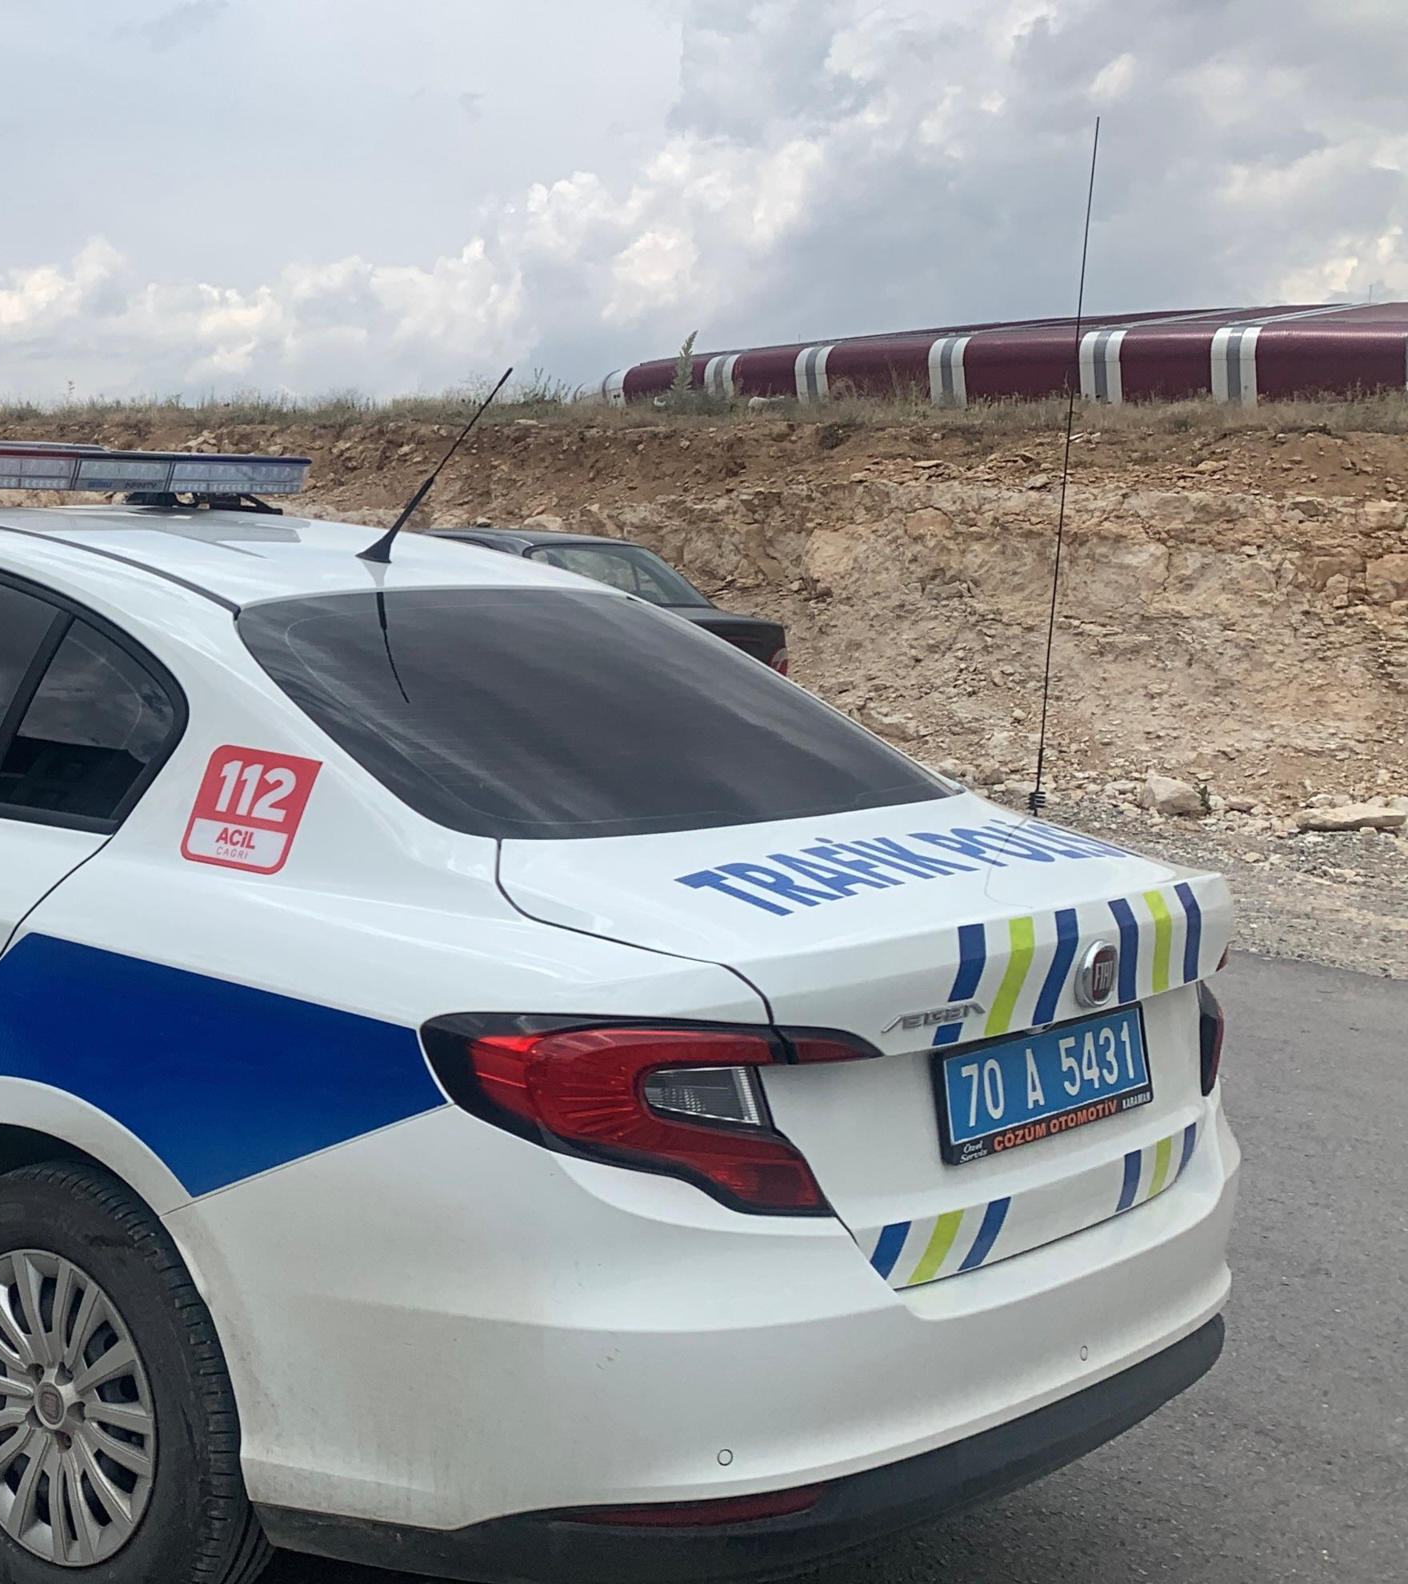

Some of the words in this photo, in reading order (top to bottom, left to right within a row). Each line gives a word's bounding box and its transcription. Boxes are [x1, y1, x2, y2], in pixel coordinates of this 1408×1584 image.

[214, 760, 297, 823] 112
[674, 837, 981, 917] TRAFİK
[906, 818, 1128, 868] POLİS
[961, 1059, 1006, 1128] 70
[1025, 1048, 1046, 1110] A
[1058, 1021, 1135, 1098] 5431
[1050, 1099, 1118, 1133] OTOMOTİV
